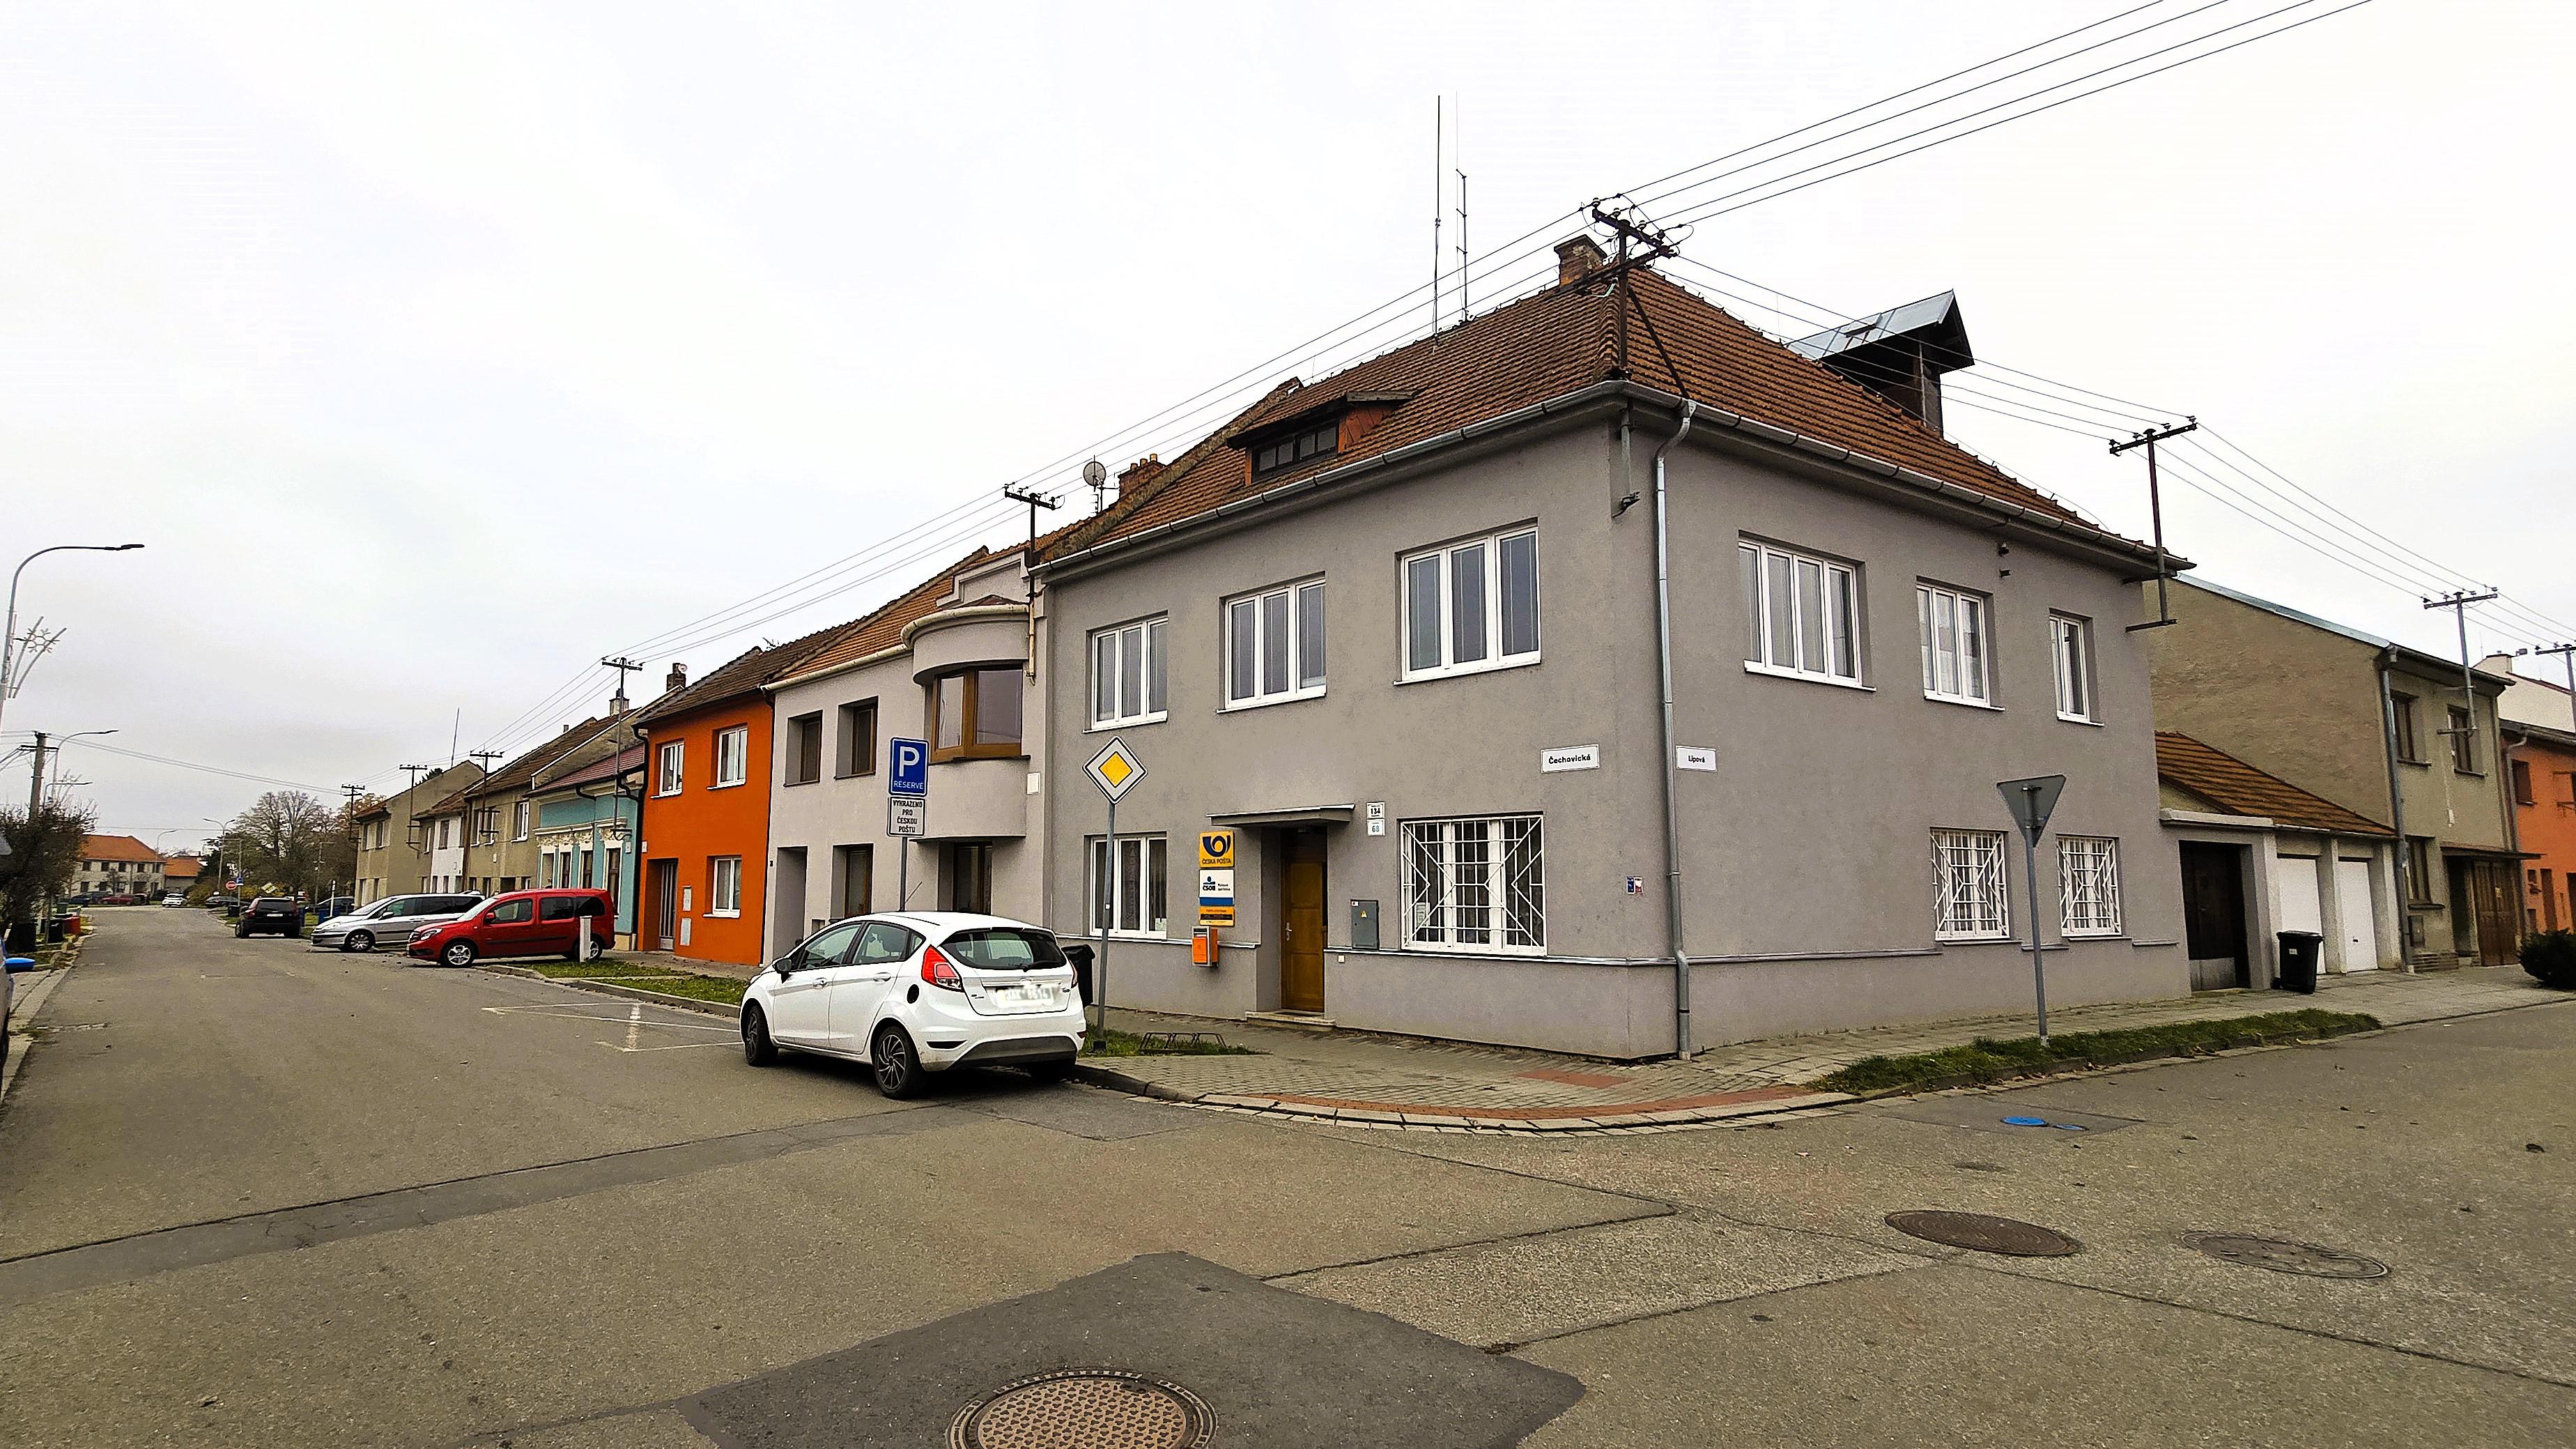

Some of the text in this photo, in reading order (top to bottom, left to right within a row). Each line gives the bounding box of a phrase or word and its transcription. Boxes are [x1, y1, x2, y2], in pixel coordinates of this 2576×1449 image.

[899, 746, 920, 777] P
[1548, 753, 1591, 764] Čechovická
[1688, 755, 1705, 763] Lipová
[893, 799, 923, 808] VYHRAZENO
[897, 815, 918, 825] ČESKOU
[898, 825, 916, 833] POŠTU
